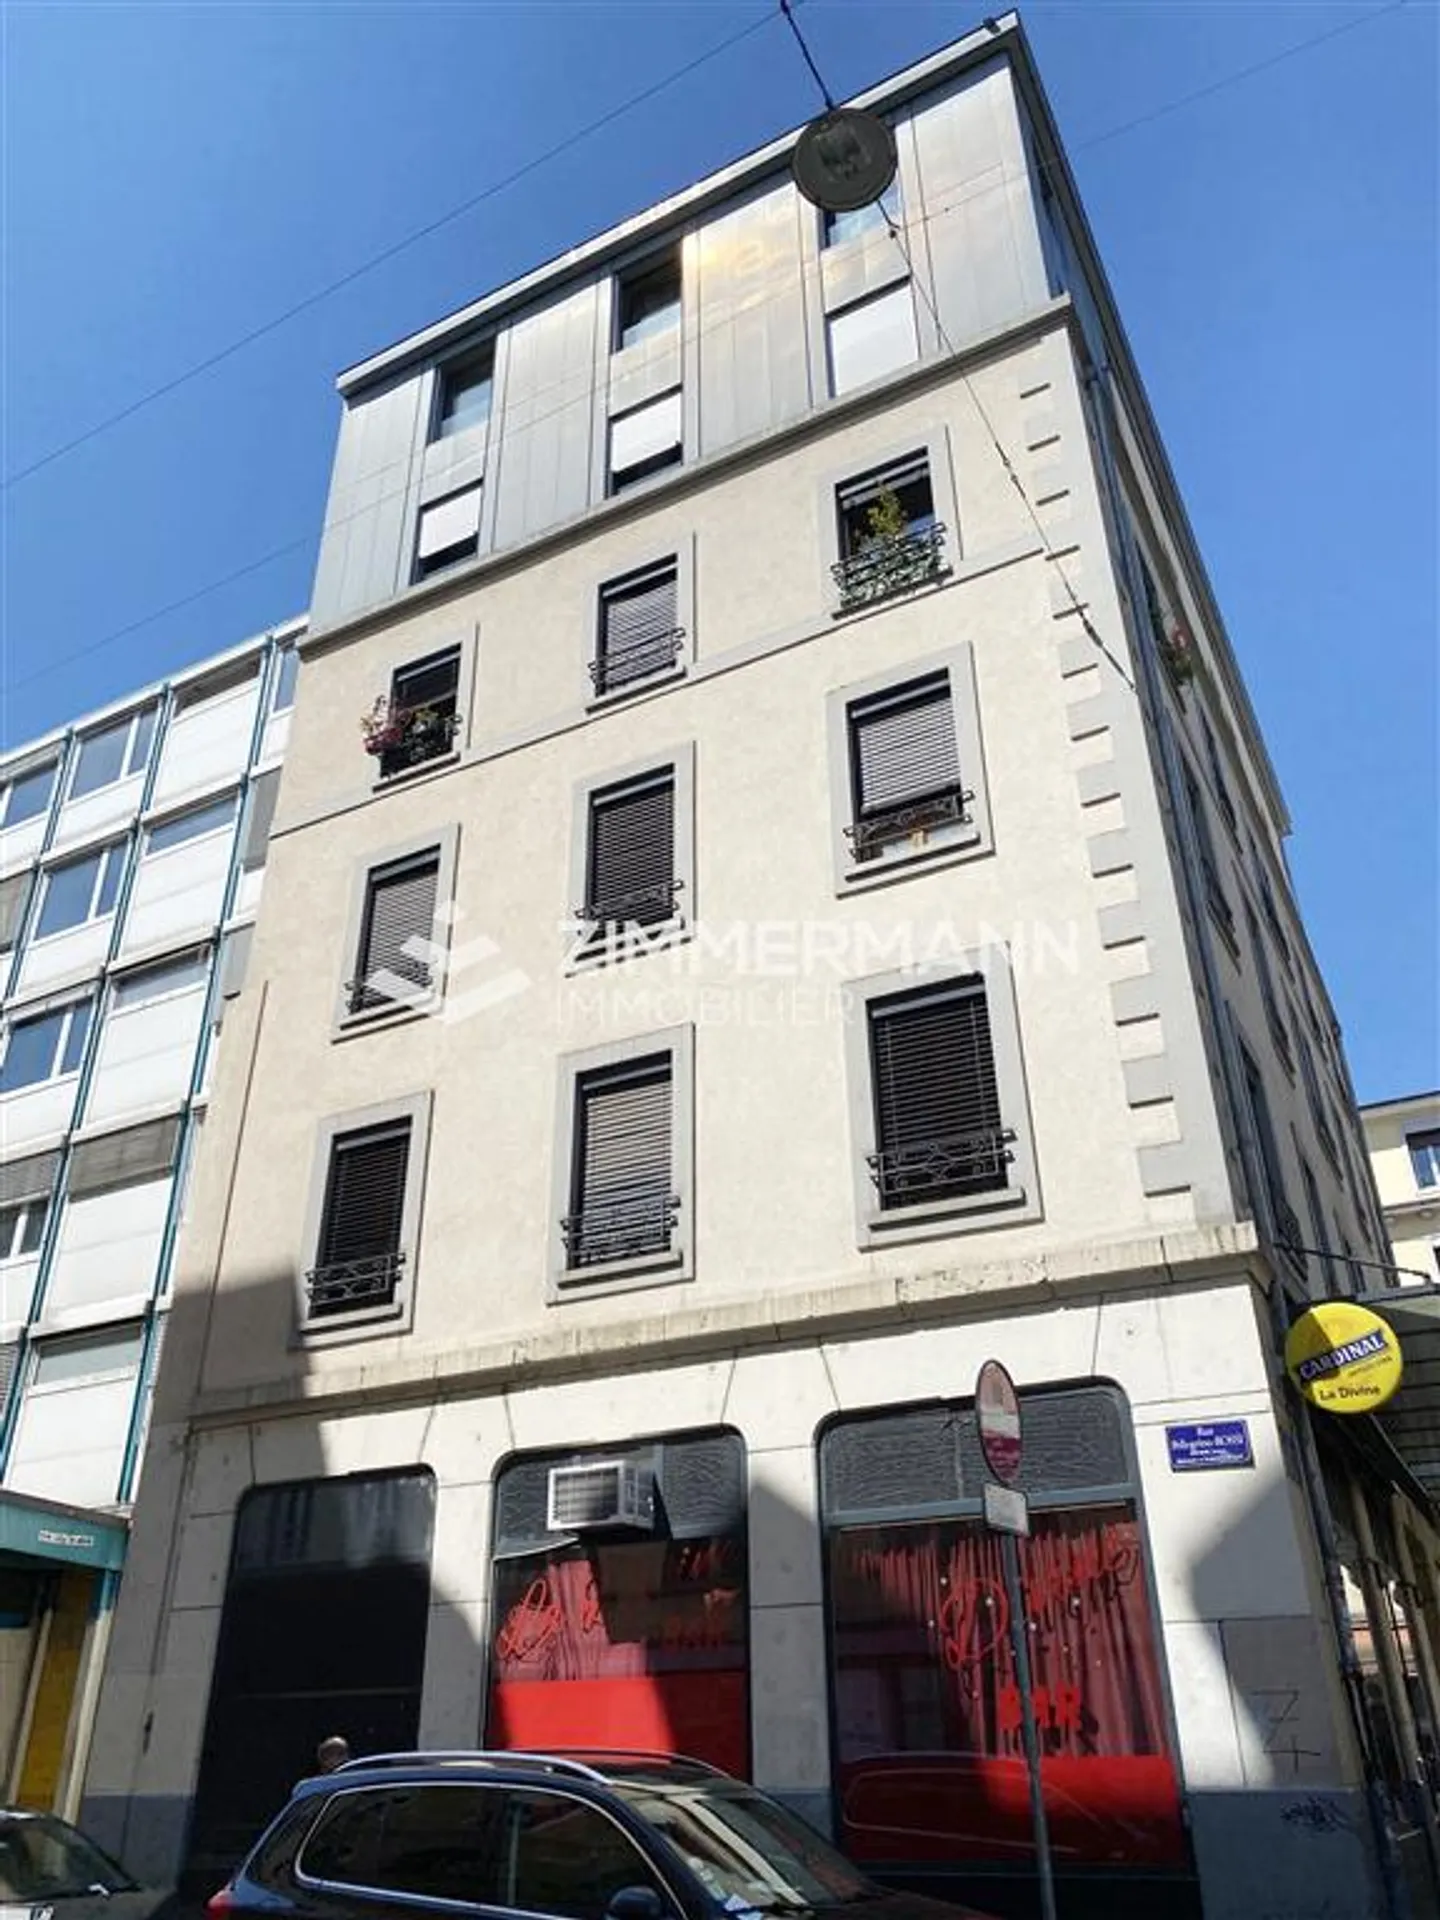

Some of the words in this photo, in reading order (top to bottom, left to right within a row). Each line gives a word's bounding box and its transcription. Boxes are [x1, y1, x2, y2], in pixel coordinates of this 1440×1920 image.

[1300, 1333, 1385, 1379] CARDINAL
[1319, 1389, 1336, 1400] La
[1338, 1384, 1381, 1399] Divine
